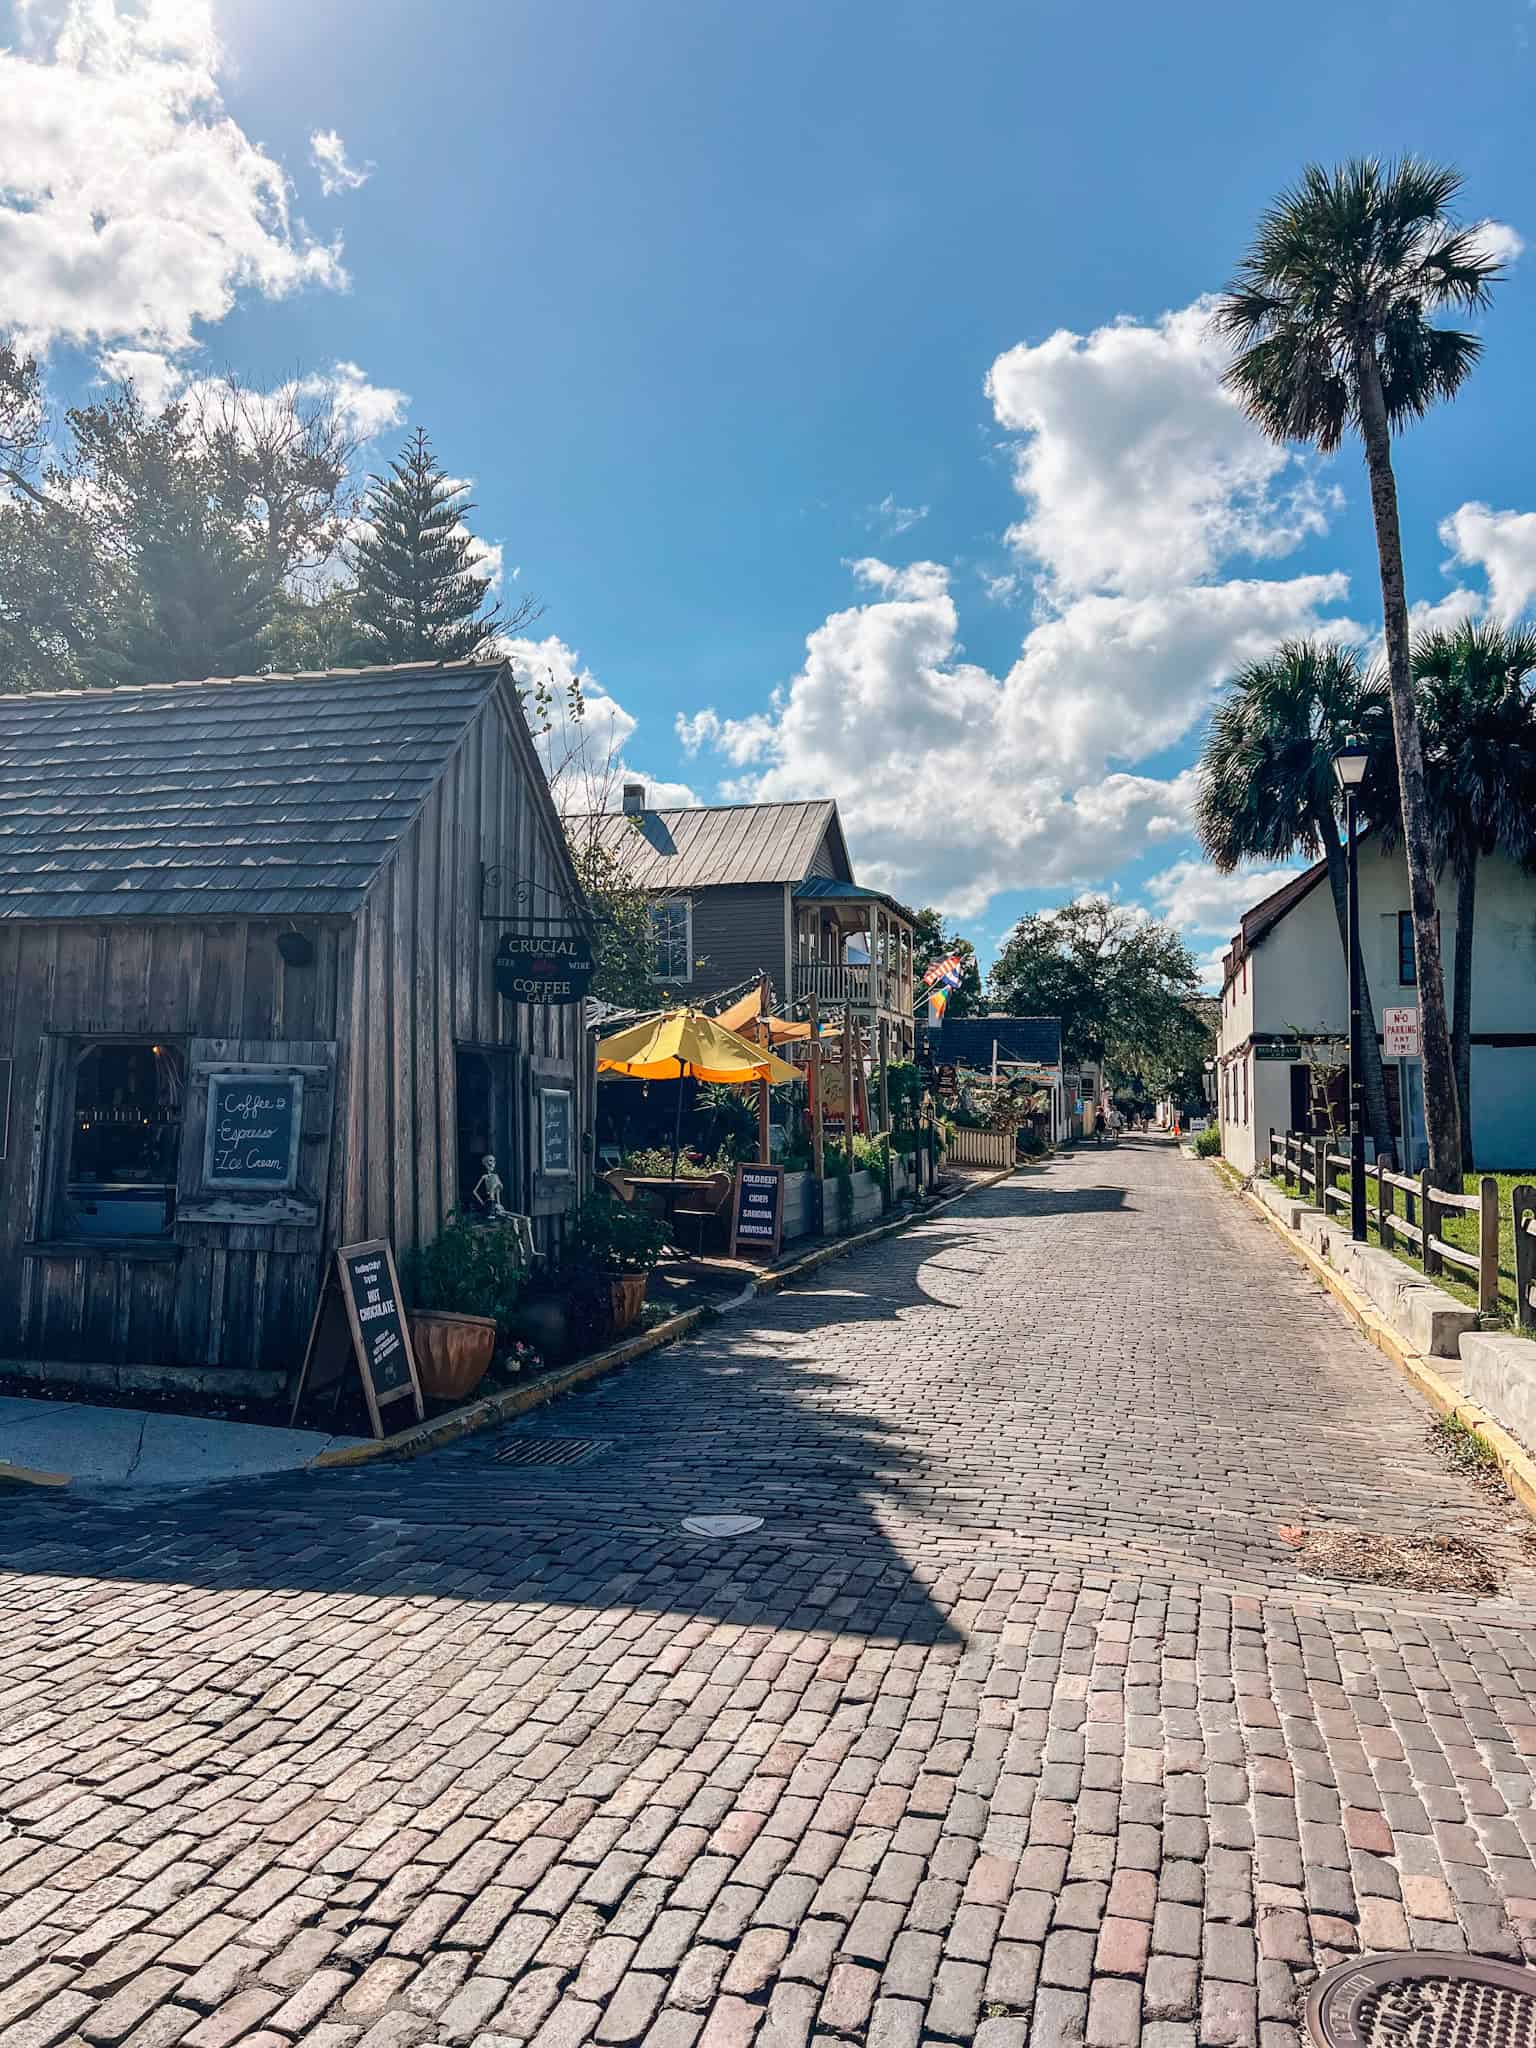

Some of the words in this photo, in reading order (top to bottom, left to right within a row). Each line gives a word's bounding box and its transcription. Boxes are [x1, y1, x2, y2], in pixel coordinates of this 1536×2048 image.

[508, 940, 578, 956] CRUCIAL
[512, 979, 571, 995] COFFEE
[526, 993, 553, 1003] CAFE
[1393, 1014, 1409, 1024] NO
[1386, 1024, 1417, 1035] PARKING
[246, 1148, 283, 1169] Cream
[743, 1174, 760, 1184] COLD
[760, 1175, 778, 1185] BEER
[748, 1194, 769, 1204] CIDER
[367, 1288, 380, 1304] HOT
[359, 1299, 395, 1322] CHOCOLATE
